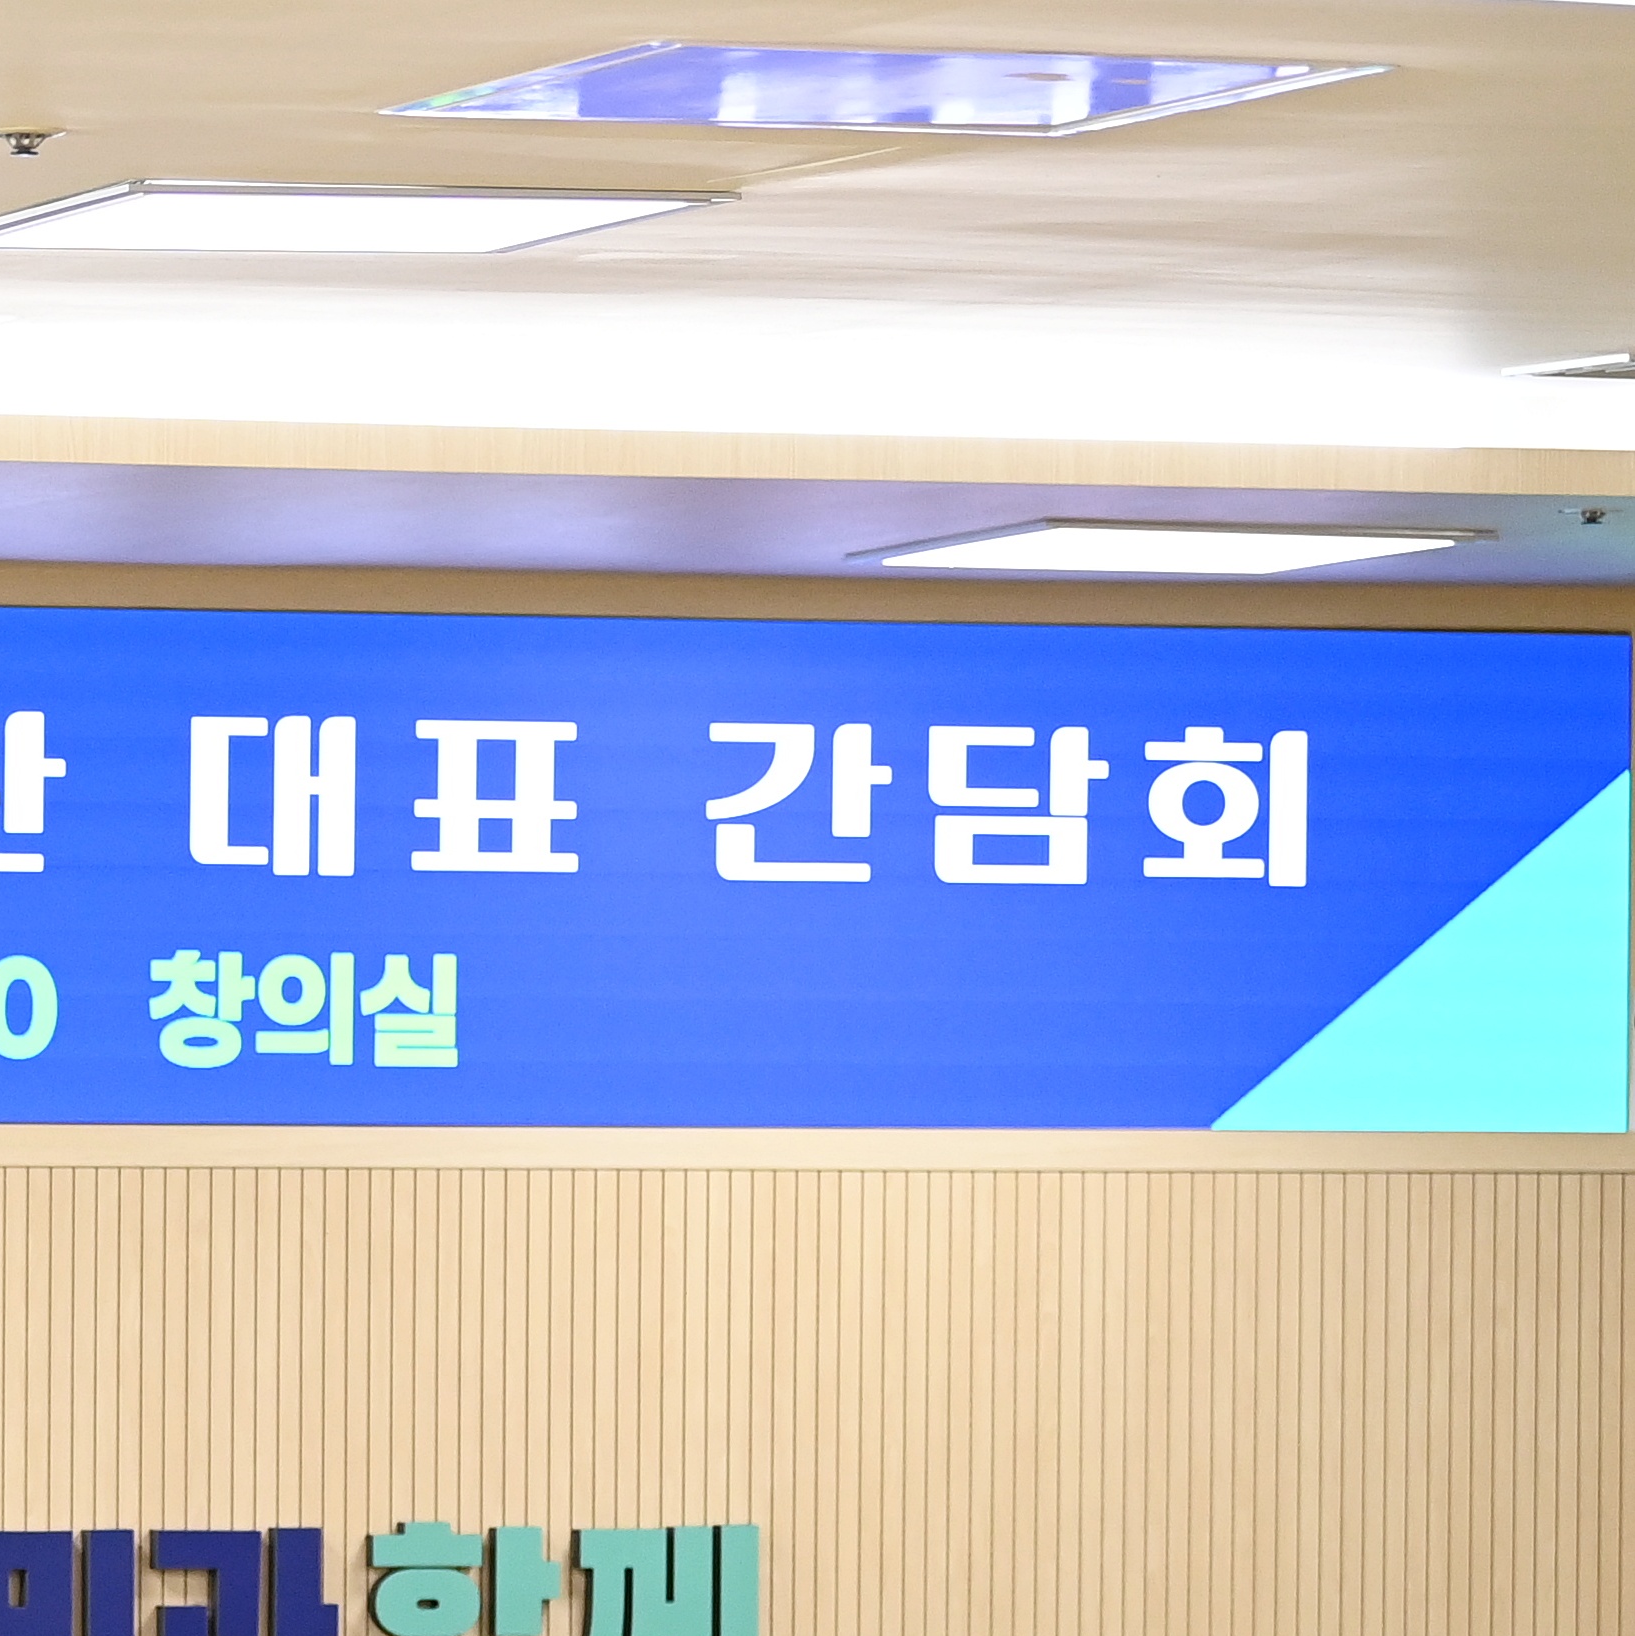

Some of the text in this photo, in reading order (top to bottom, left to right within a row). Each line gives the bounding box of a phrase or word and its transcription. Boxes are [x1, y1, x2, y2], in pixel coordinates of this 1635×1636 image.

[190, 715, 579, 877] 대표
[706, 722, 1308, 887] 간담회
[149, 949, 459, 1069] 창의실
